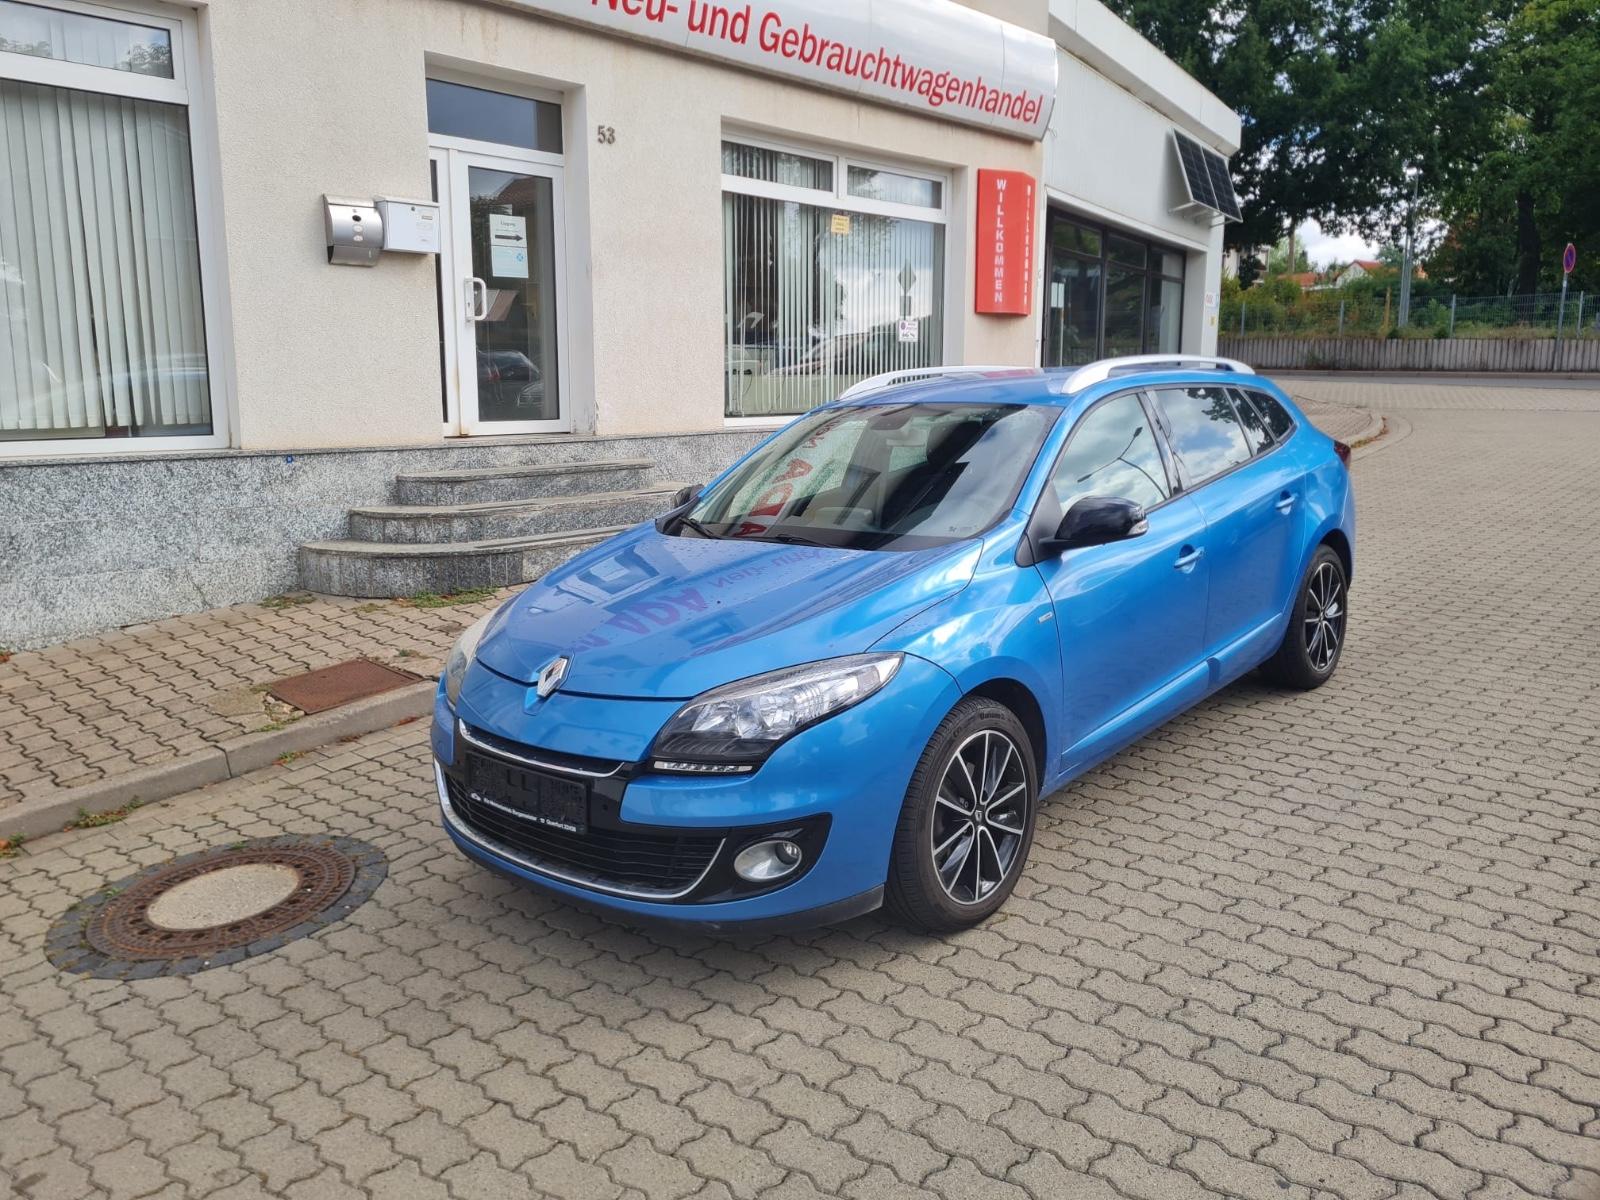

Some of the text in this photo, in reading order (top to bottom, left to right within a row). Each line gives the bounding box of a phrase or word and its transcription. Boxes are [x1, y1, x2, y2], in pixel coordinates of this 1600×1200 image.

[591, 0, 1043, 124] eu- und Gebrauchtwagenhandel
[597, 125, 616, 145] 53
[994, 178, 1007, 303] WILLKOMMEN
